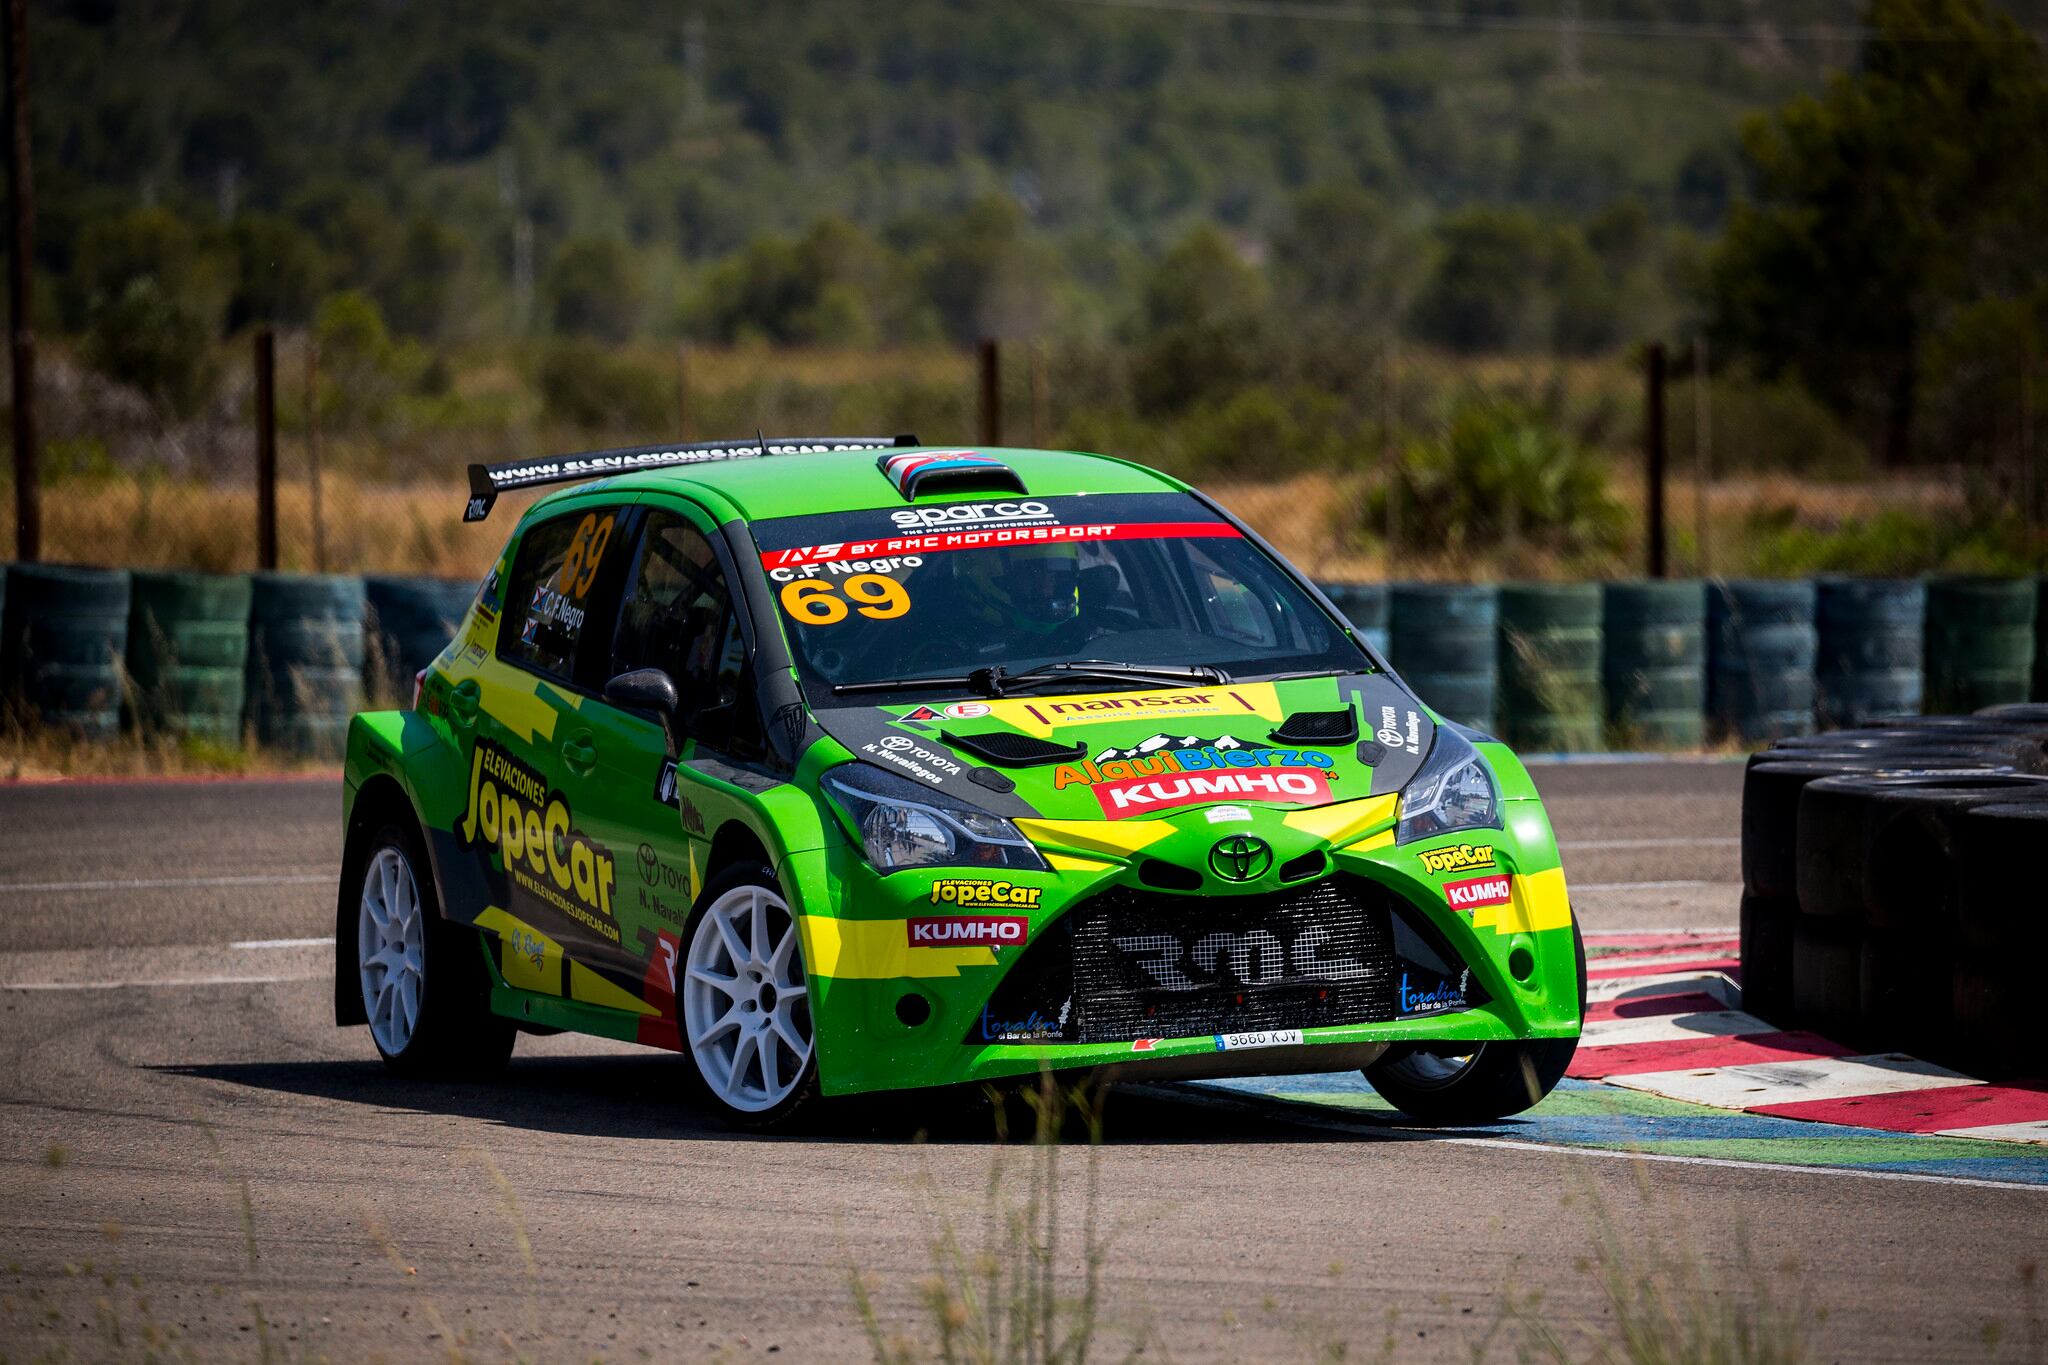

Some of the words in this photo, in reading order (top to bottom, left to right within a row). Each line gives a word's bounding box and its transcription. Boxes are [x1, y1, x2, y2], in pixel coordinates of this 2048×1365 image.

[891, 502, 1052, 527] sparco
[926, 526, 963, 534] POWER
[982, 520, 1060, 530] PERFORMANCE
[851, 543, 879, 555] BY
[888, 537, 938, 551] RMC
[947, 526, 1116, 545] MOTORSPORT
[560, 512, 614, 599] 69
[770, 563, 821, 582] C.F
[827, 556, 923, 575] Negro
[781, 574, 911, 625] 69
[1049, 694, 1215, 714] nansar
[1382, 706, 1397, 730] TOYOTA
[862, 743, 877, 753] N.
[910, 746, 961, 775] TOYOTA
[484, 748, 545, 807] ELEVACIONES
[1109, 774, 1318, 808] KUMHO
[462, 746, 615, 915] JopeCar
[1418, 844, 1493, 874] JopeCar
[931, 881, 1041, 905] JopeCar
[1449, 881, 1509, 905] KUMHO
[514, 870, 620, 943] WWW.ELEVACIONESJOPECAR.COM
[914, 922, 1020, 940] KUMHO
[1421, 1002, 1433, 1010] Bar
[1433, 1001, 1442, 1009] de
[1006, 1031, 1020, 1040] Bar
[1021, 1031, 1031, 1039] de
[1229, 1033, 1266, 1046] 9660
[1271, 1031, 1297, 1043] KJV
